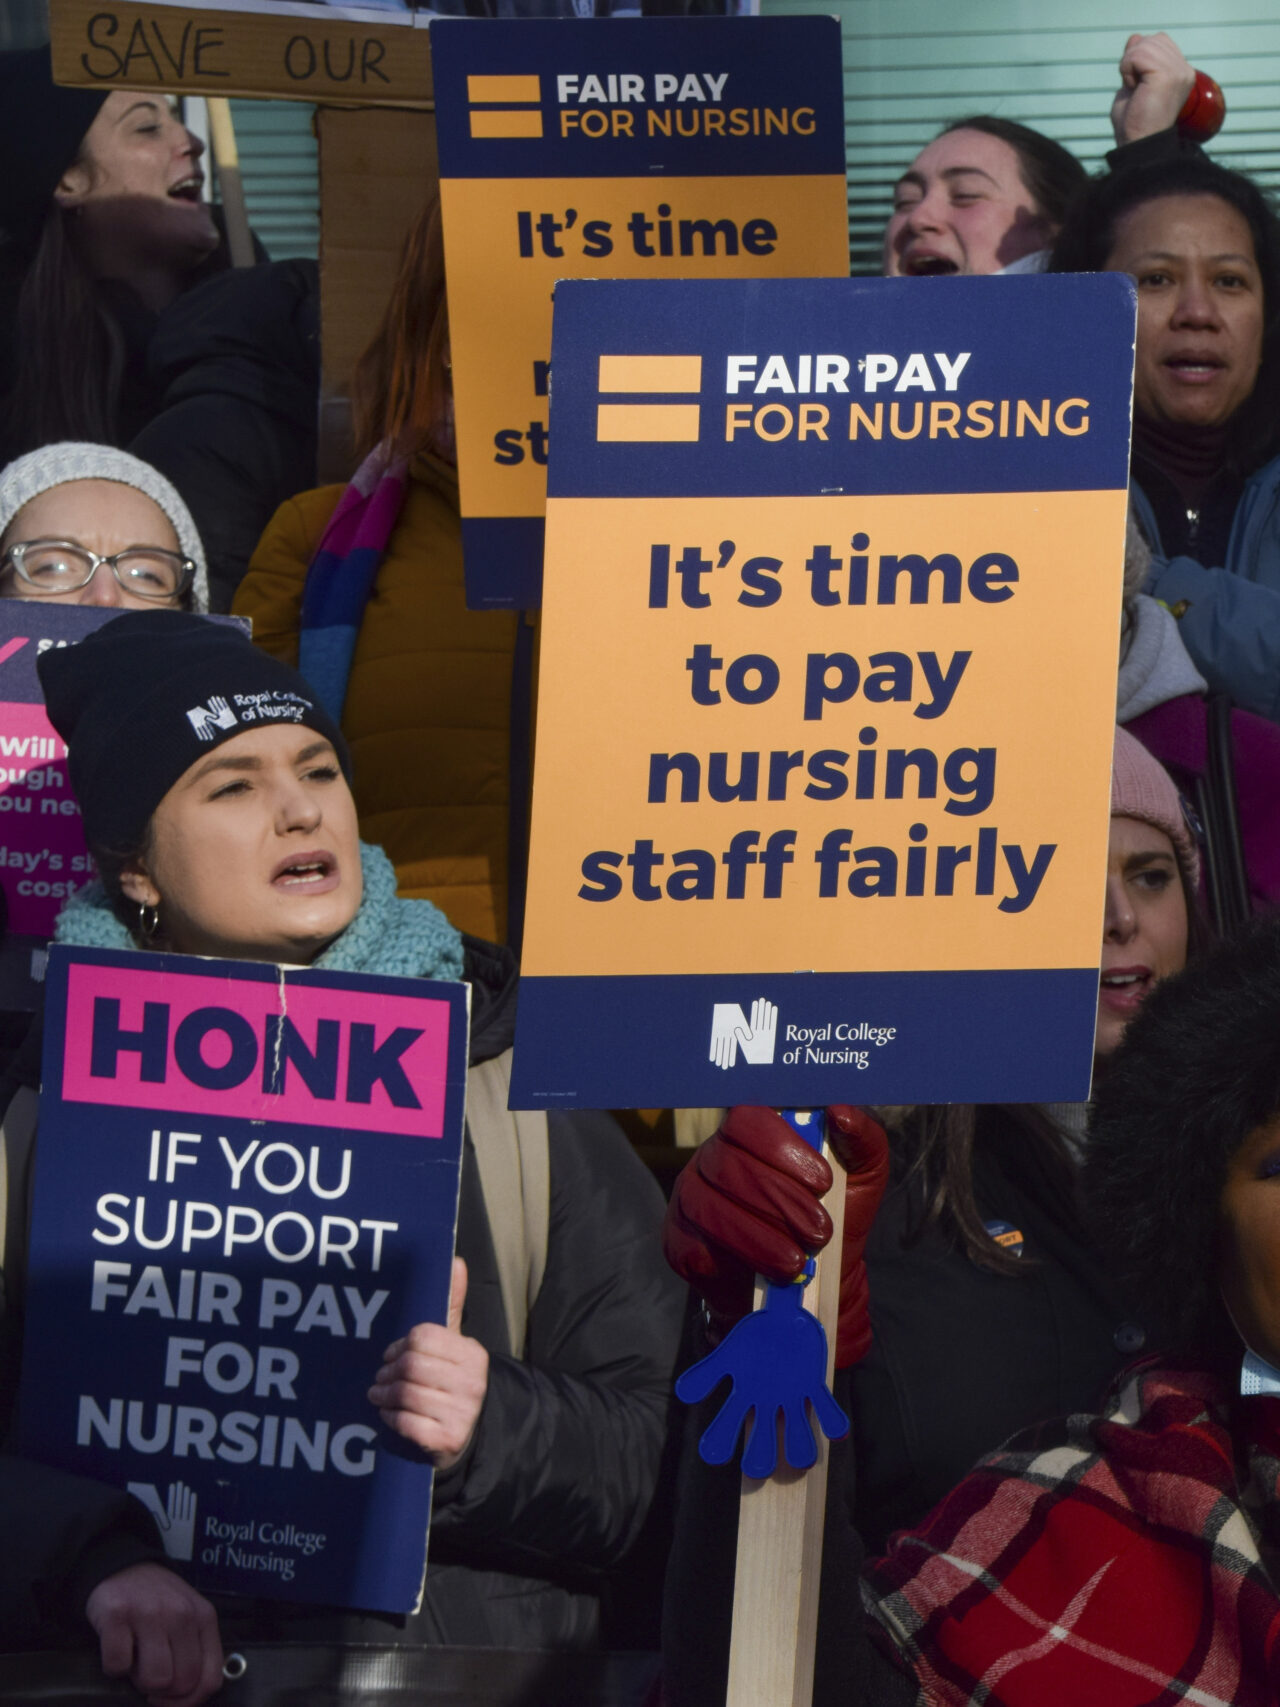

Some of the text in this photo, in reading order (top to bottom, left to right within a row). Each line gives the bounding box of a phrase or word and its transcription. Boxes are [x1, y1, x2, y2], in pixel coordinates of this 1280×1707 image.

[81, 13, 390, 84] SAVE OUR
[557, 74, 728, 102] FAIR PAY
[560, 107, 816, 138] FOR NURSING
[518, 204, 777, 258] It's time
[727, 353, 971, 393] FAIR PAY
[726, 398, 1089, 442] FOR NURSING
[649, 353, 971, 608] It's time
[686, 644, 972, 720] to pay
[242, 706, 256, 721] of
[0, 736, 55, 759] Will
[648, 727, 996, 816] nursing
[578, 823, 1057, 913] staff fairly
[90, 996, 424, 1110] HONK
[783, 1047, 869, 1069] of Nursing
[786, 1023, 896, 1047] Royal College
[149, 1131, 351, 1199] IF YOU
[92, 1194, 398, 1273] SUPPORT
[92, 1260, 389, 1338] FAIR PAY
[165, 1337, 299, 1399] FOR
[78, 1396, 377, 1476] NURSING
[202, 1544, 295, 1581] of Nursing
[206, 1517, 326, 1555] Royal College
